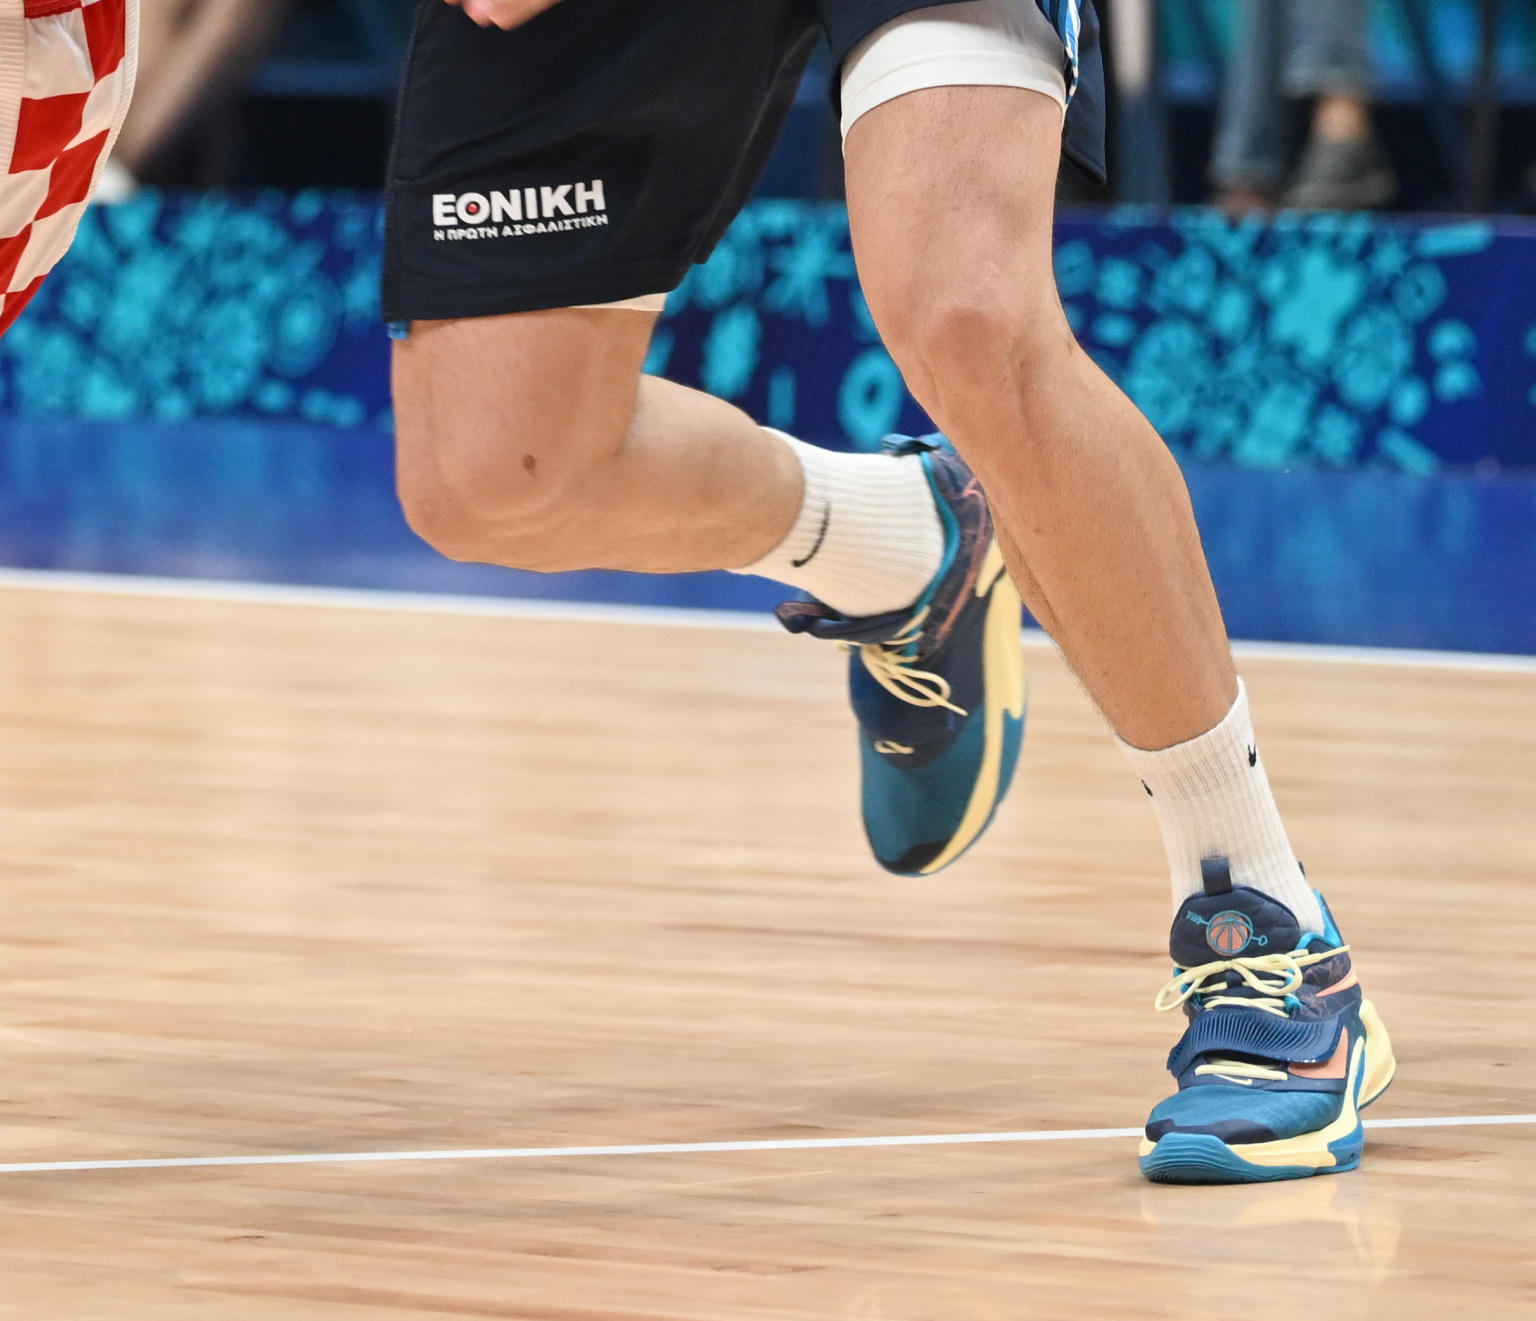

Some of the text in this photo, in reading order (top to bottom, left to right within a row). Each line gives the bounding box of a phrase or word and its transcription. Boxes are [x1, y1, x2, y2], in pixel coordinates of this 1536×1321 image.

[432, 179, 606, 226] ΕΘΝΙΚΗ
[447, 227, 499, 241] ΠΡΩΤΗ
[501, 213, 609, 237] ΑΣΦΑΛΙΣΤΙΚΗ
